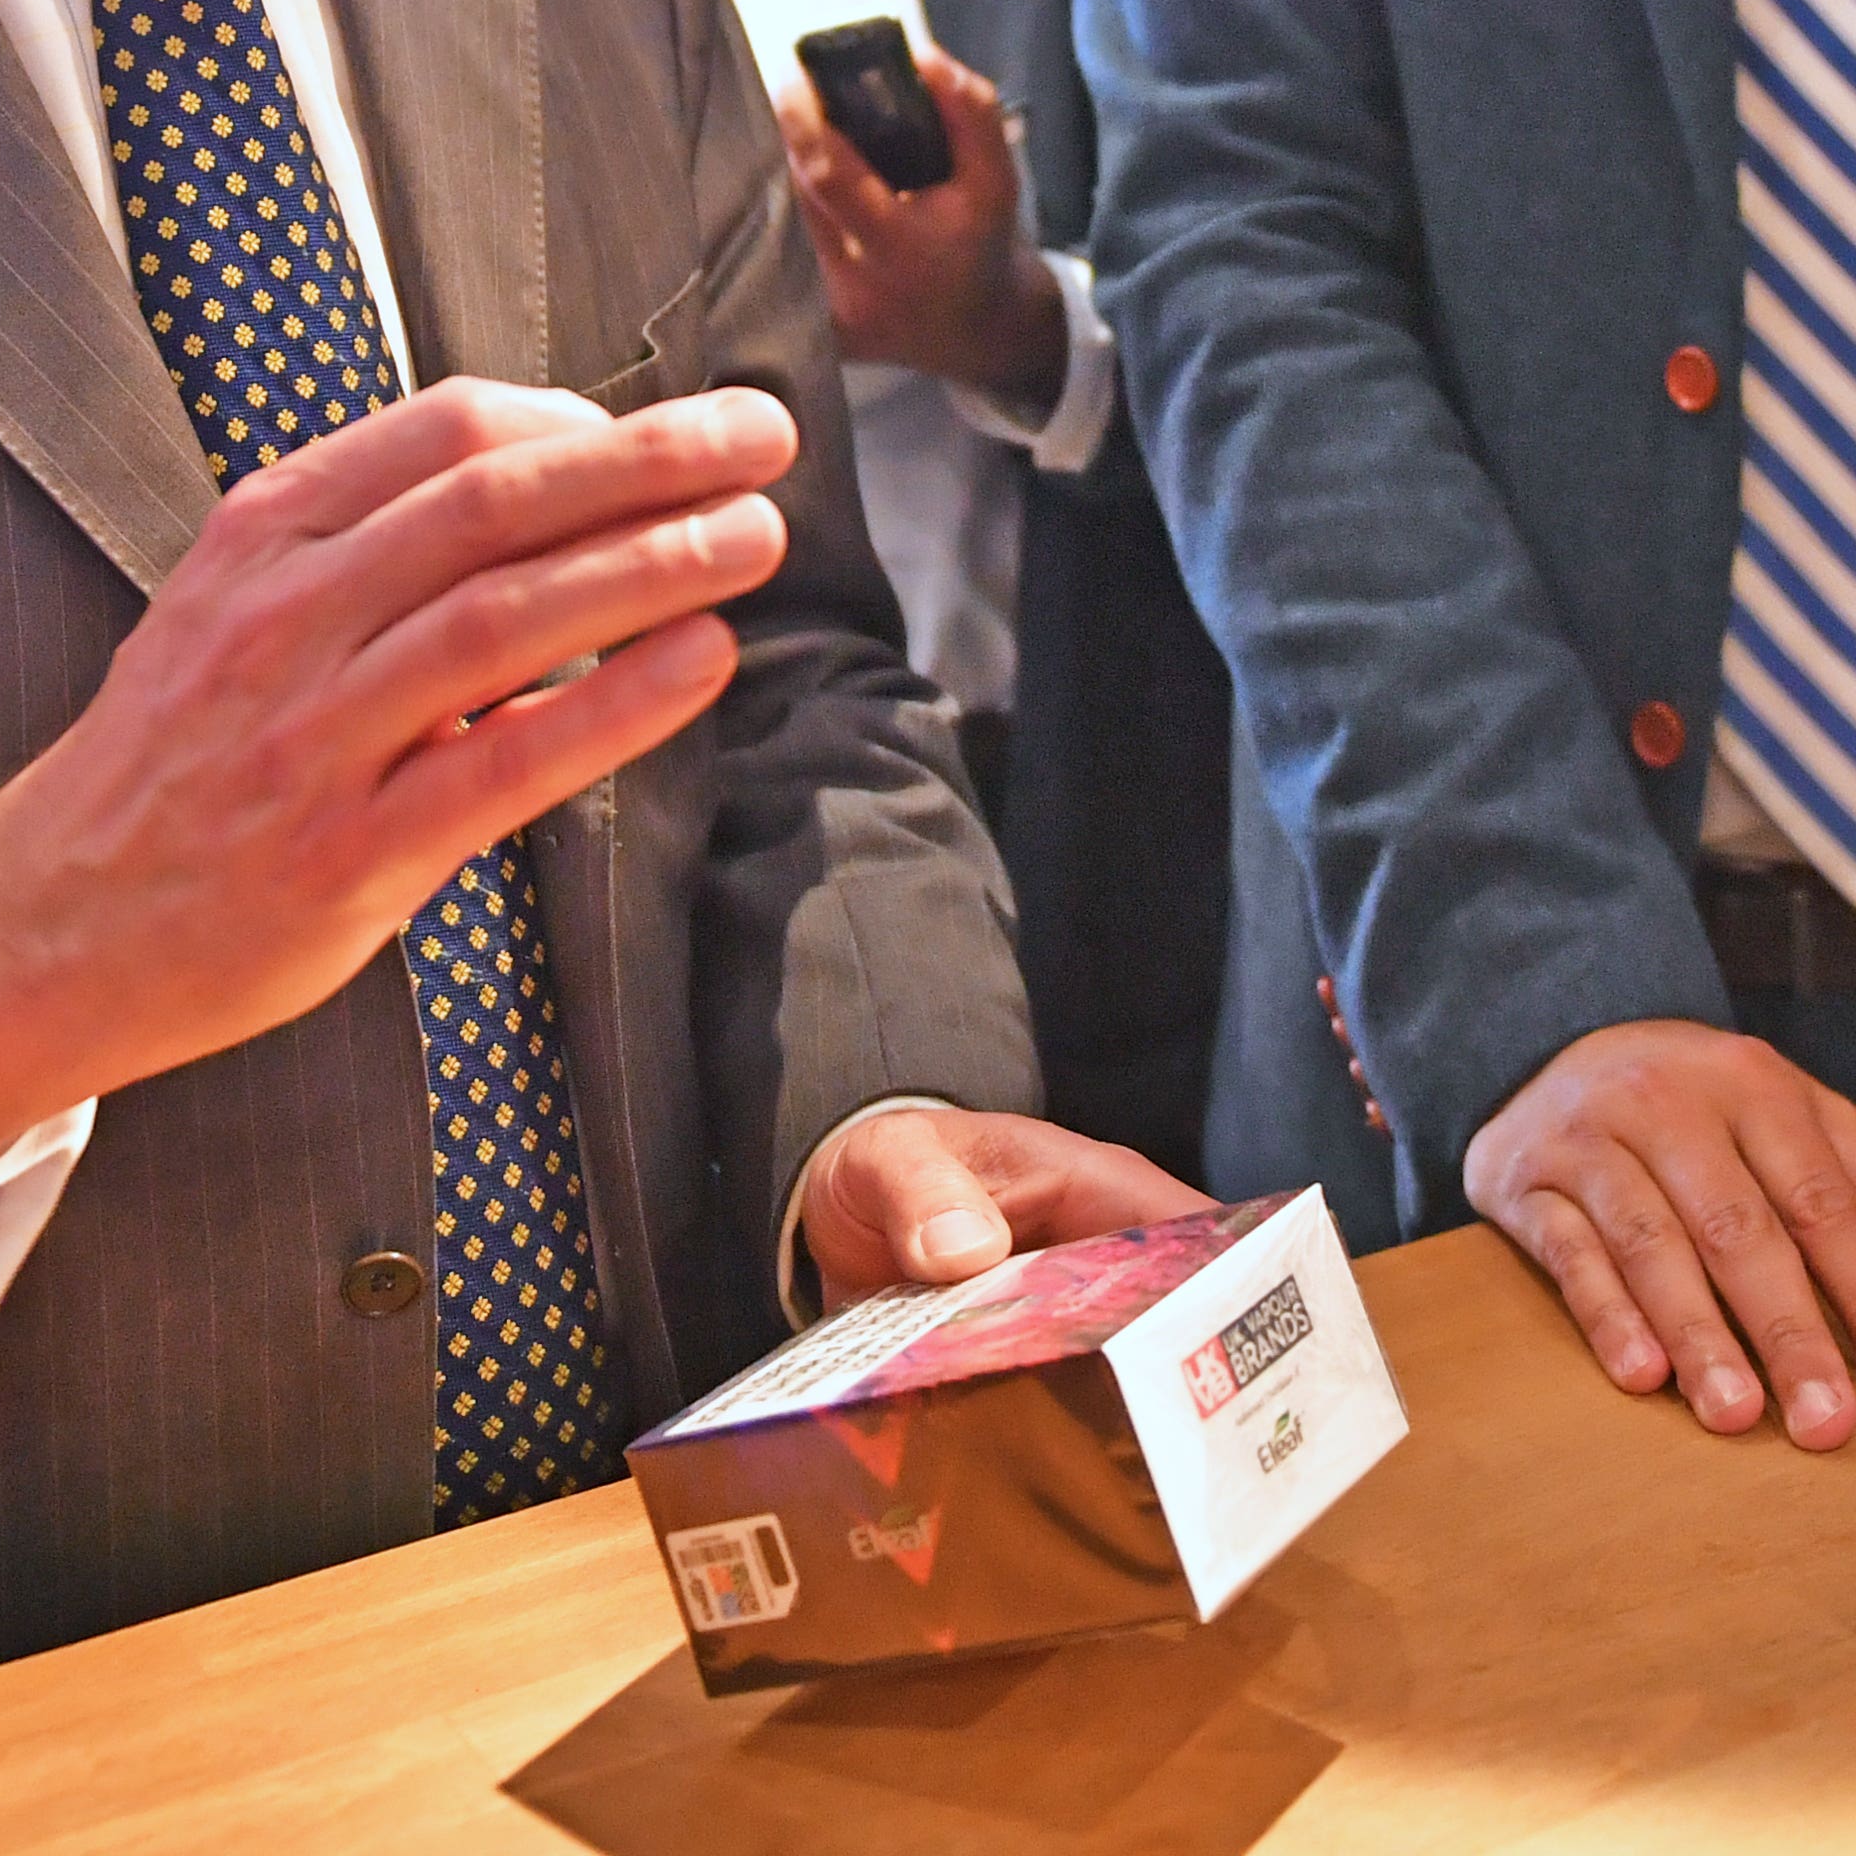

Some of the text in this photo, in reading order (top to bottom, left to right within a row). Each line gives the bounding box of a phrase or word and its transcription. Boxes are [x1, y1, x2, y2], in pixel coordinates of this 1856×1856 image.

[1244, 1280, 1301, 1332] VAPOUR
[1229, 1301, 1310, 1386] BRANDS
[1256, 1415, 1304, 1474] Eleaf
